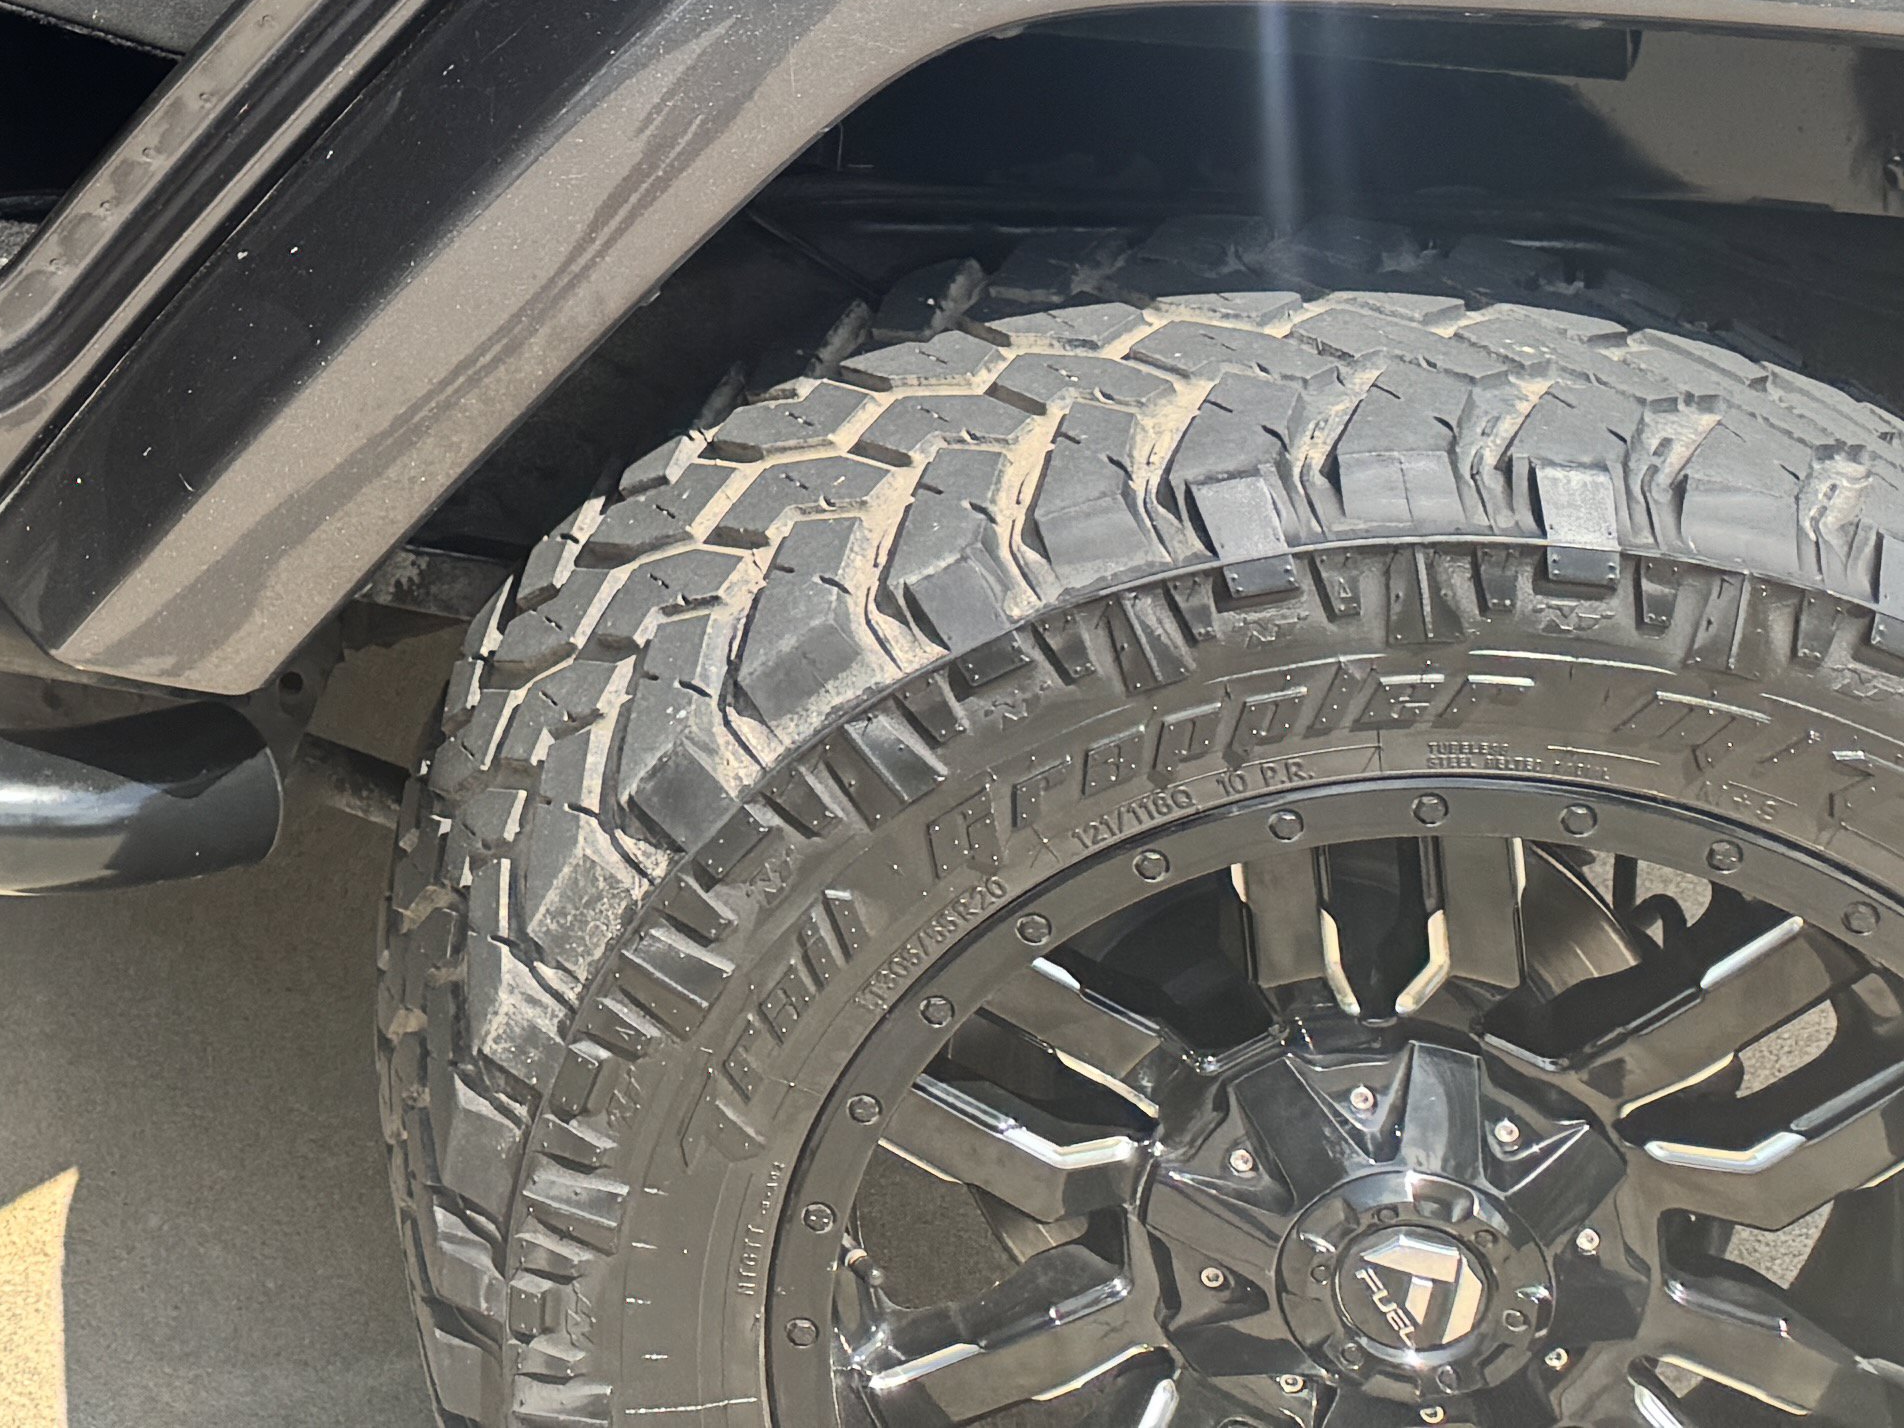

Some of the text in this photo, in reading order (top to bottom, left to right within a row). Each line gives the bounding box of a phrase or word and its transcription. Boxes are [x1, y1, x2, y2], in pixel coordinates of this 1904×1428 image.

[927, 652, 1535, 874] Grappler
[1426, 754, 1477, 769] STEEL
[1071, 789, 1198, 850] 121/118Q
[1214, 767, 1250, 797] 10
[1354, 1266, 1416, 1348] FUEL
